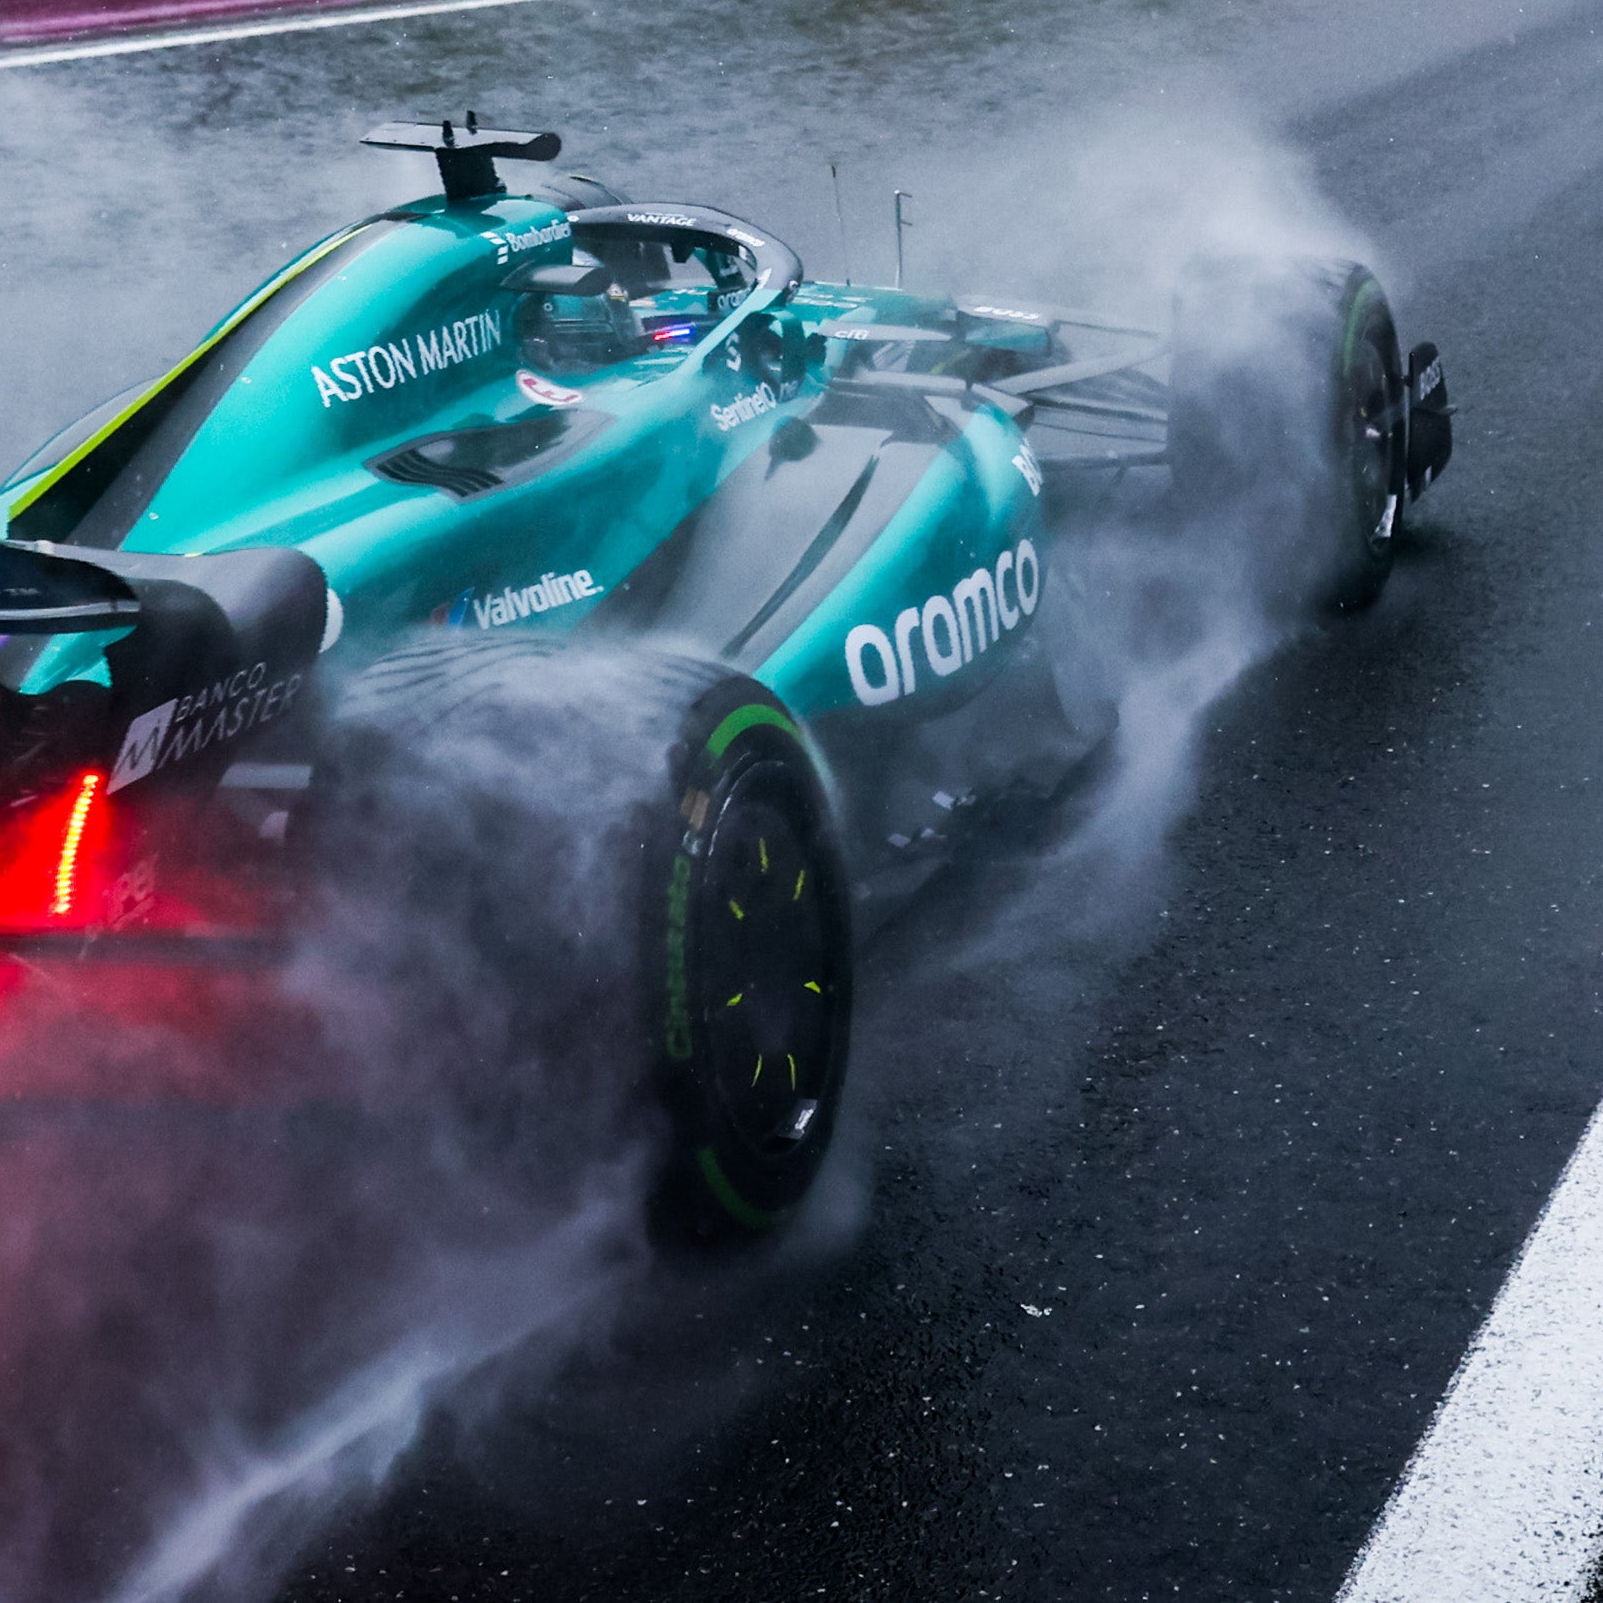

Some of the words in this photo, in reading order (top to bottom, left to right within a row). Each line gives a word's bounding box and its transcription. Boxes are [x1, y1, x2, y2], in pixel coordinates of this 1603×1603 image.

[627, 213, 697, 226] VANTAGE
[311, 338, 417, 408] ASTON
[416, 308, 501, 375] MARTIN
[834, 328, 870, 340] citi
[844, 538, 1039, 707] aramco
[175, 661, 267, 723] BANCO
